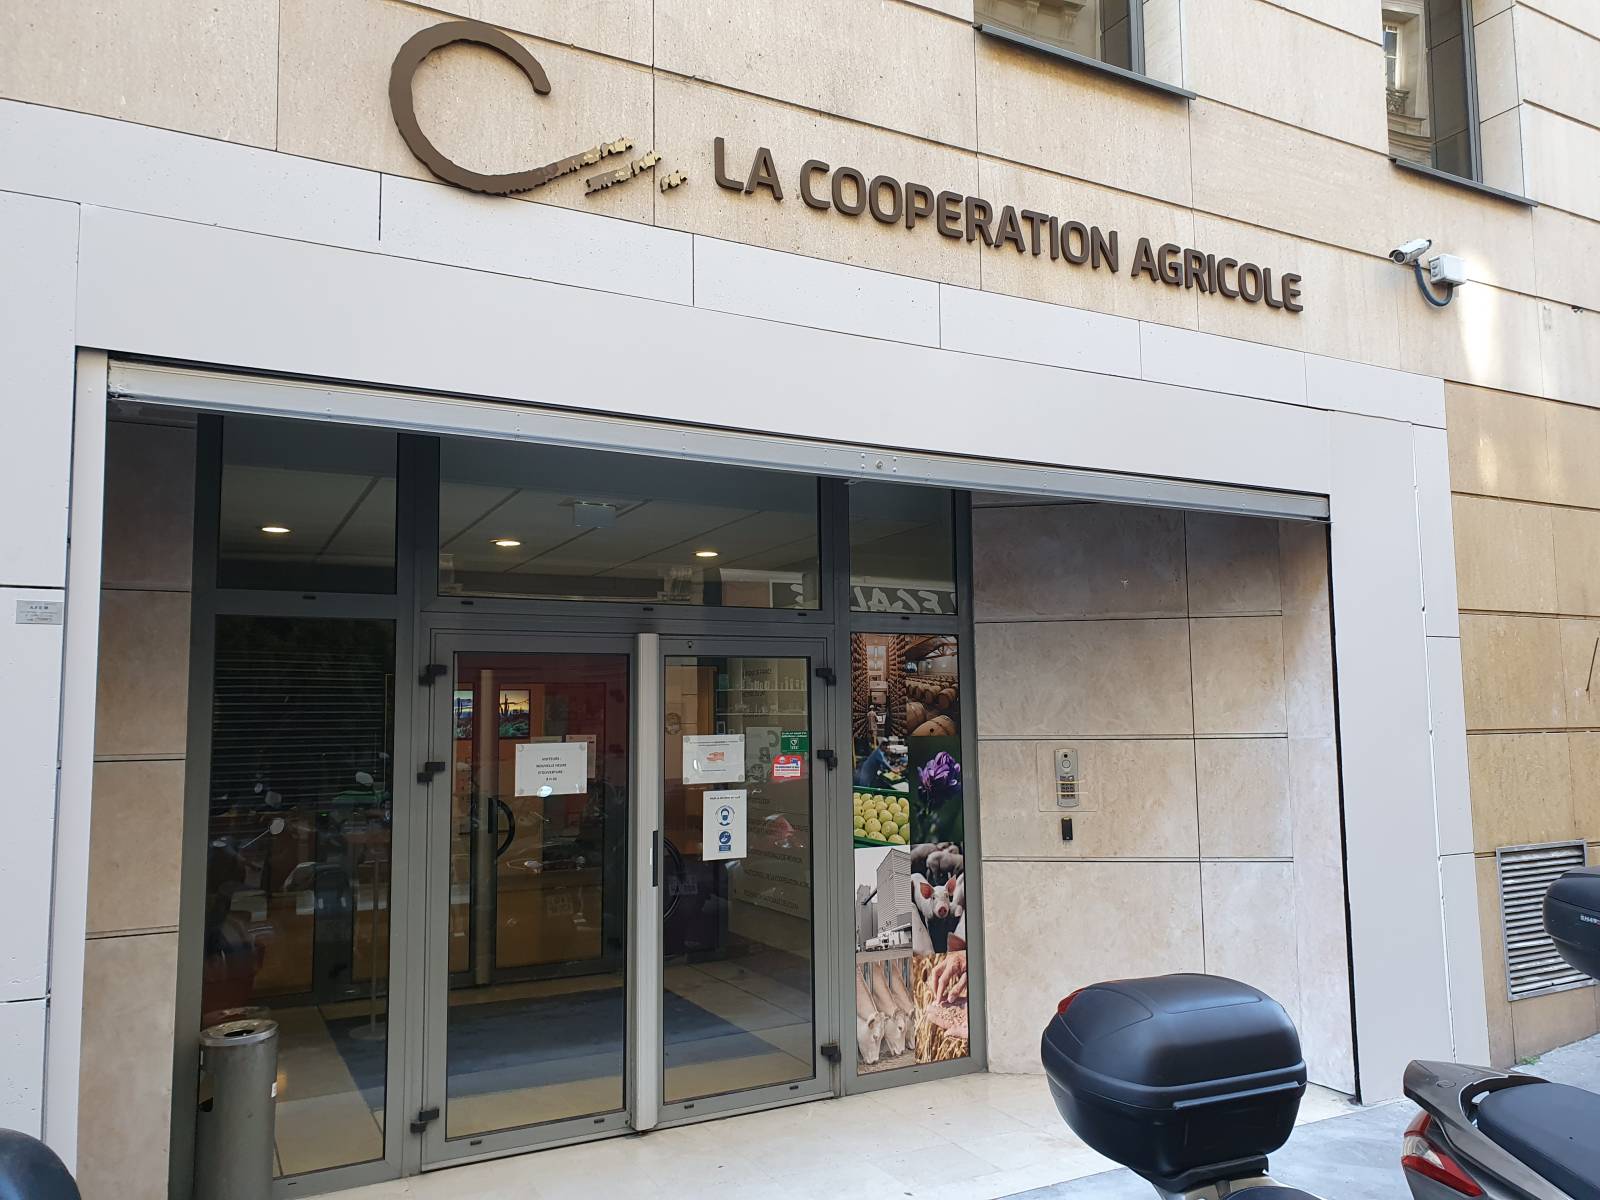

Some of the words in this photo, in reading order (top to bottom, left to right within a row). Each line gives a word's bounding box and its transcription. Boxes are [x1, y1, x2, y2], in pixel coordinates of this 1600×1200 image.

[714, 136, 783, 201] LA
[800, 159, 1119, 273] COOPERATION
[1131, 237, 1304, 312] AGRICOLE
